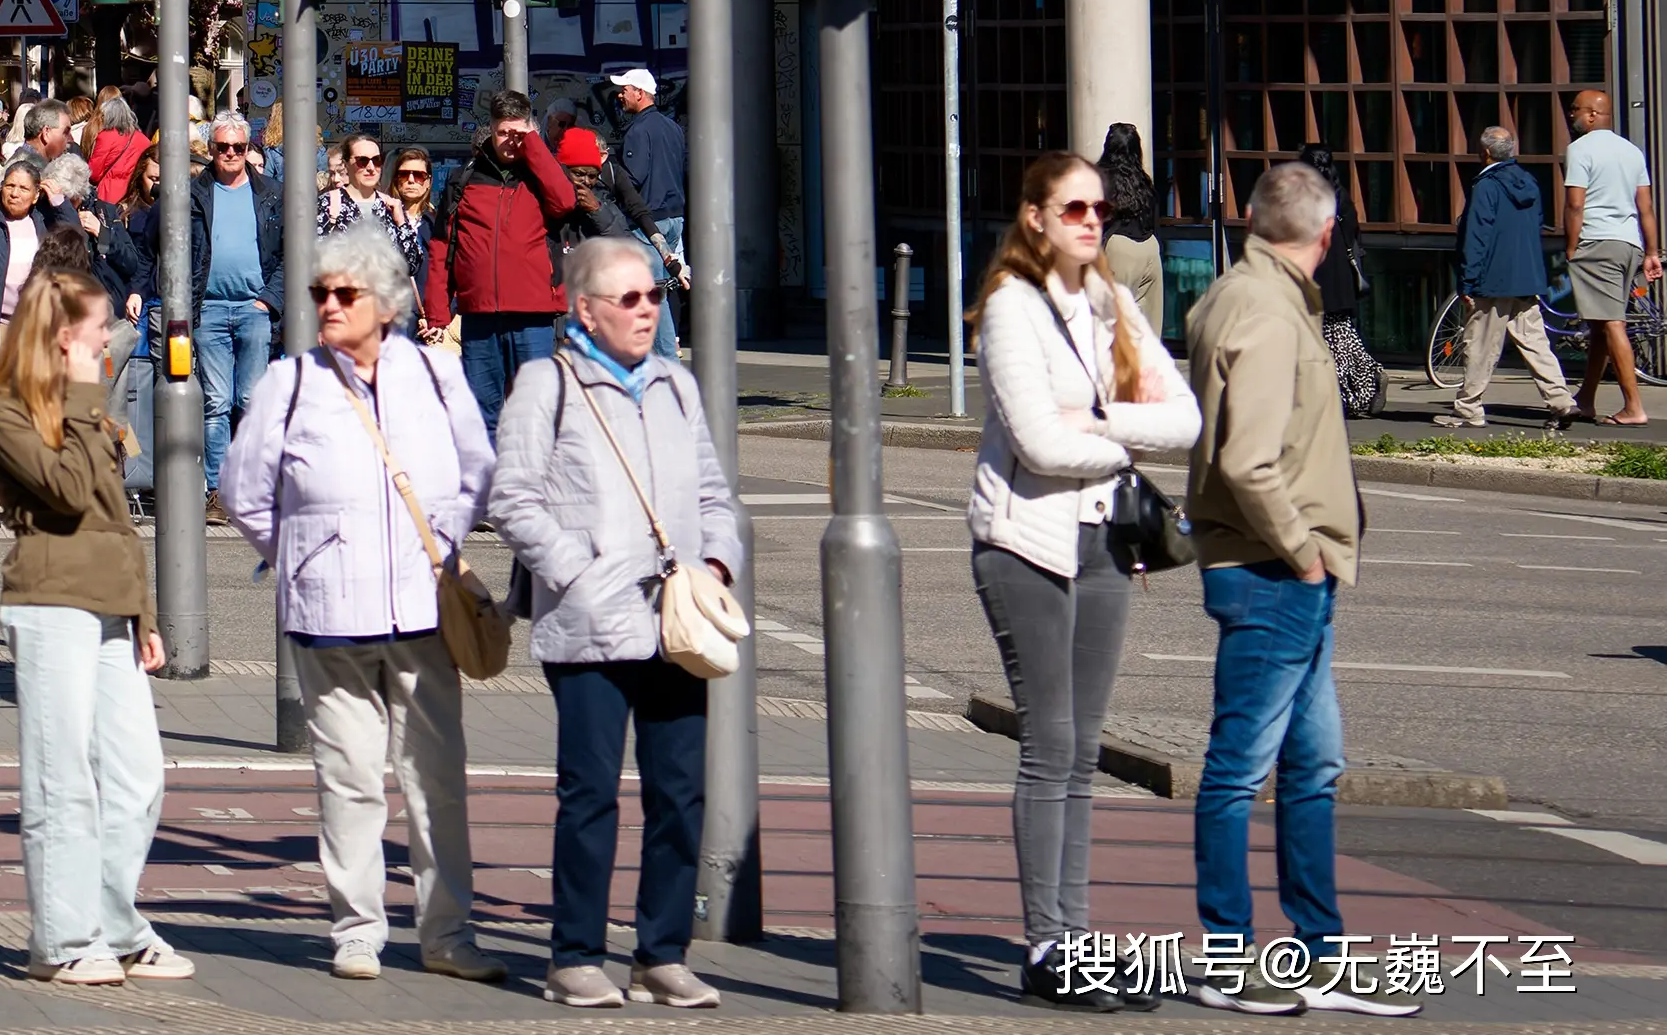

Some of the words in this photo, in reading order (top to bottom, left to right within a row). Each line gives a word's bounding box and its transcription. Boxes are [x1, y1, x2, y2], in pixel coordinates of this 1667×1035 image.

[350, 46, 378, 66] Ü30
[407, 47, 454, 61] DEINE
[360, 57, 399, 75] PARTY
[407, 60, 454, 74] PARTY
[407, 73, 421, 85] IN
[426, 73, 453, 86] DER
[407, 85, 453, 96] WACHE?
